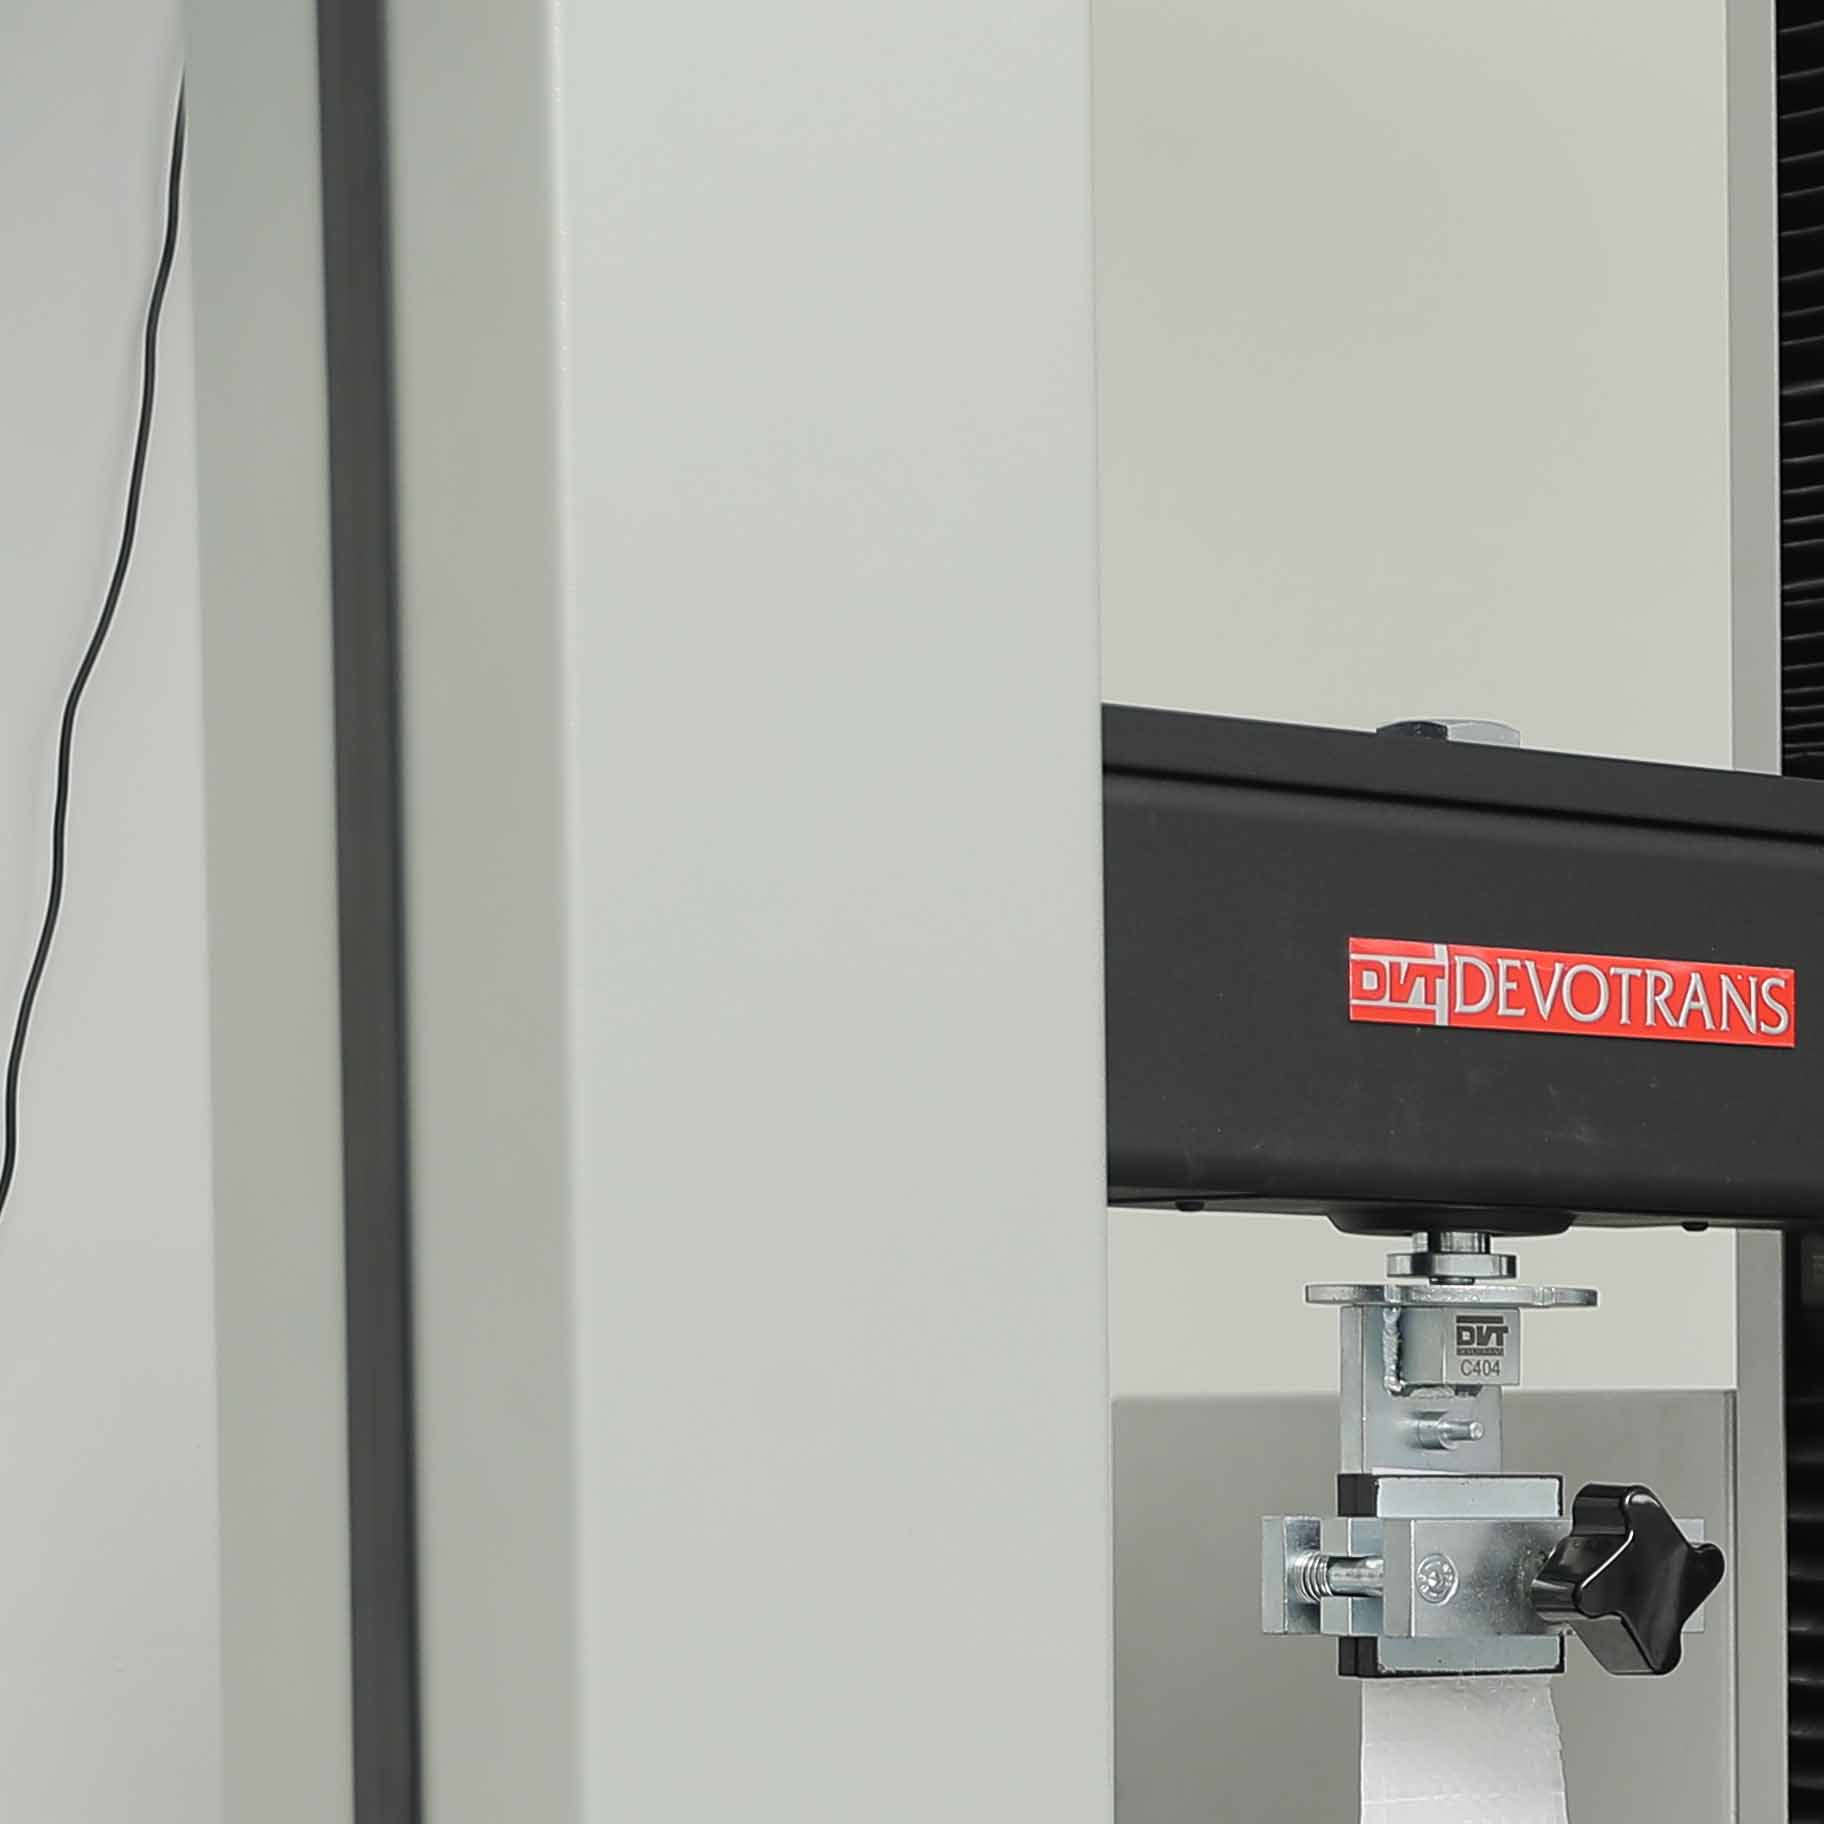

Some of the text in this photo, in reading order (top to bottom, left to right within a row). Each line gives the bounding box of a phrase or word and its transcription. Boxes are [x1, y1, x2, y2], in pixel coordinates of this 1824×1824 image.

[1453, 954, 1789, 1035] DEVOTRANS
[1456, 1325, 1508, 1346] DVT
[1461, 1359, 1501, 1377] C404
